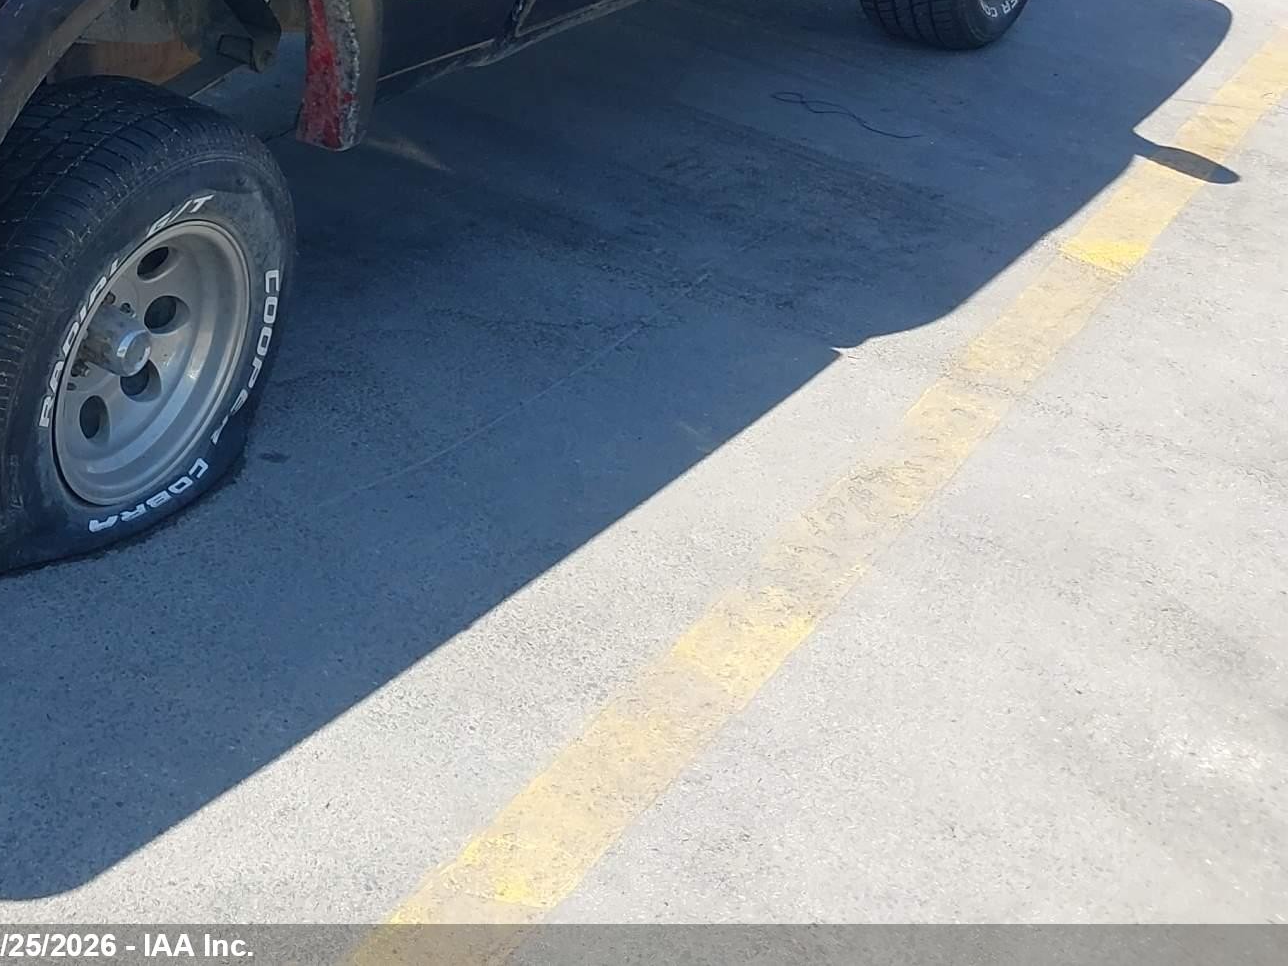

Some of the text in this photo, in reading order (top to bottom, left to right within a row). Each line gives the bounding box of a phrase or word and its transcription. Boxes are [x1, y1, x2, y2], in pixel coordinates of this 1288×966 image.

[146, 194, 215, 237] G/T
[210, 269, 280, 445] COOPER
[88, 457, 209, 533] COBRA
